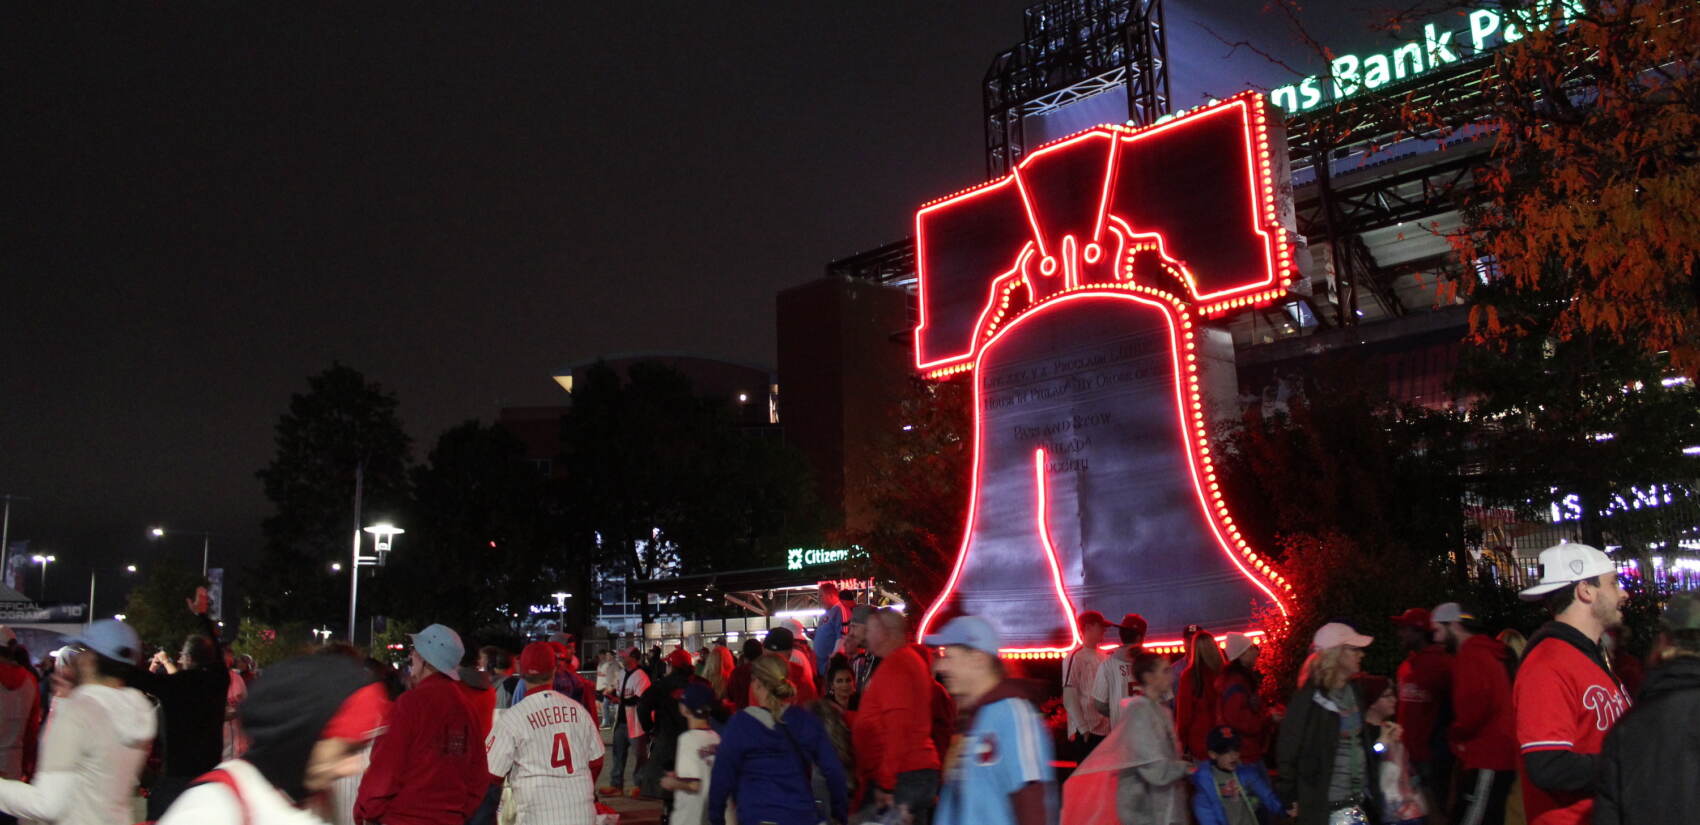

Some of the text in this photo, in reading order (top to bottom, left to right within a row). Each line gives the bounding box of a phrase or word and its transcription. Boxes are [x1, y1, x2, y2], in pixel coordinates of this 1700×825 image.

[1331, 23, 1457, 99] Bank
[527, 706, 578, 730] HUEBER
[551, 732, 574, 774] 4
